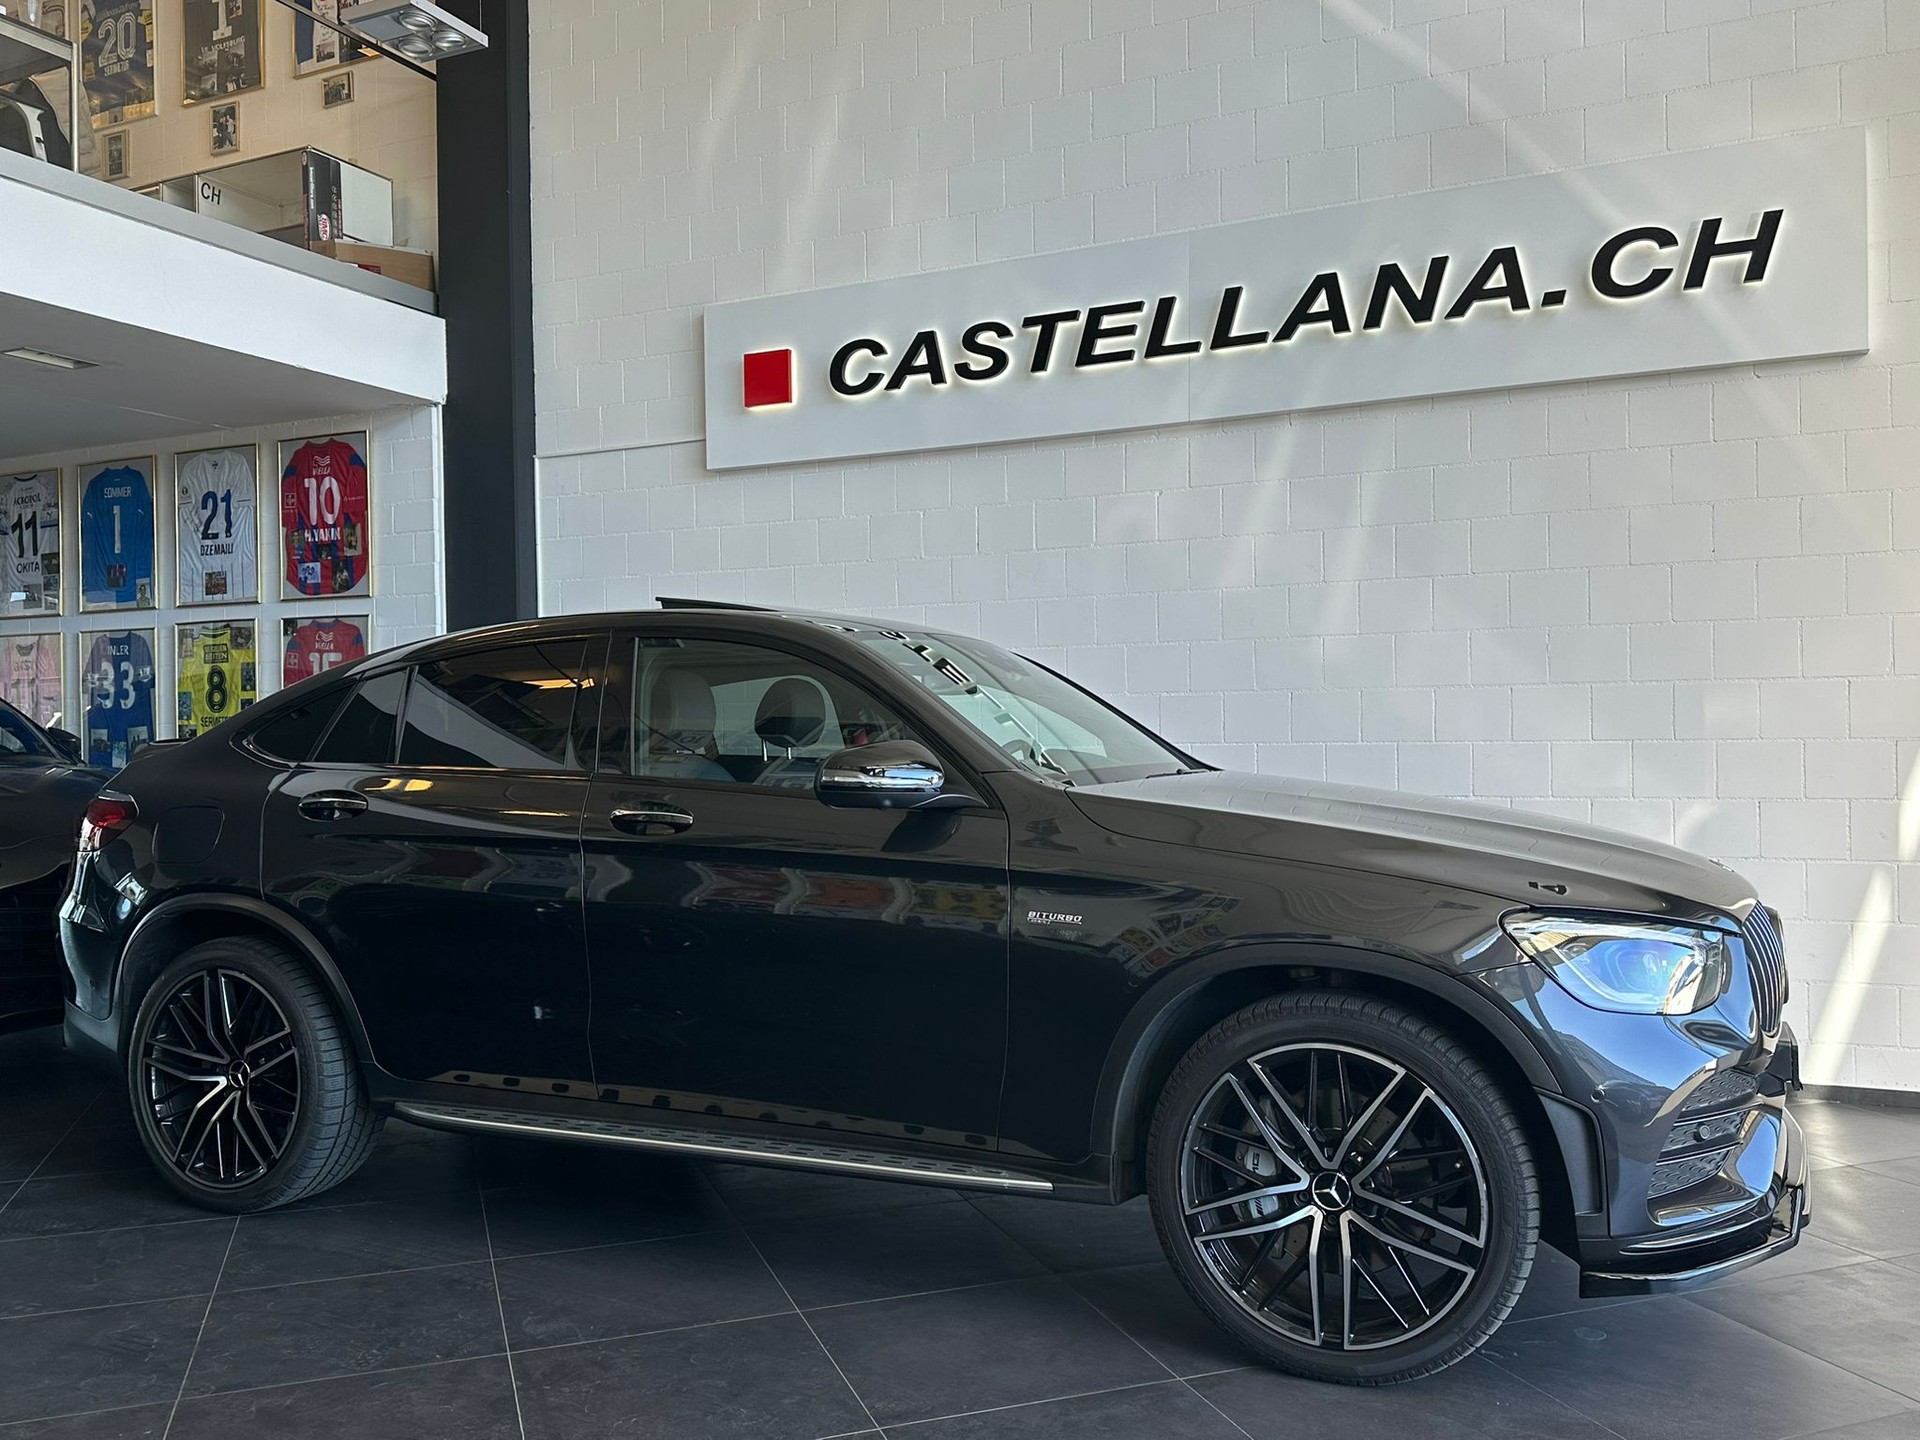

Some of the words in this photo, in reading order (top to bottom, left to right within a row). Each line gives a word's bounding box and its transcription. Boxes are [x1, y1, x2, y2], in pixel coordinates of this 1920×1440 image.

[98, 12, 136, 67] 20
[201, 182, 221, 205] CH
[828, 207, 1784, 396] CASTELLANA.CH
[104, 486, 132, 498] SOMMER
[201, 488, 233, 540] 21
[304, 475, 341, 526] 10
[11, 511, 38, 558] 11
[113, 505, 121, 554] 1
[16, 561, 40, 574] OKITA
[97, 661, 136, 710] 33
[205, 665, 228, 713] 8
[1027, 910, 1083, 922] BITURBO
